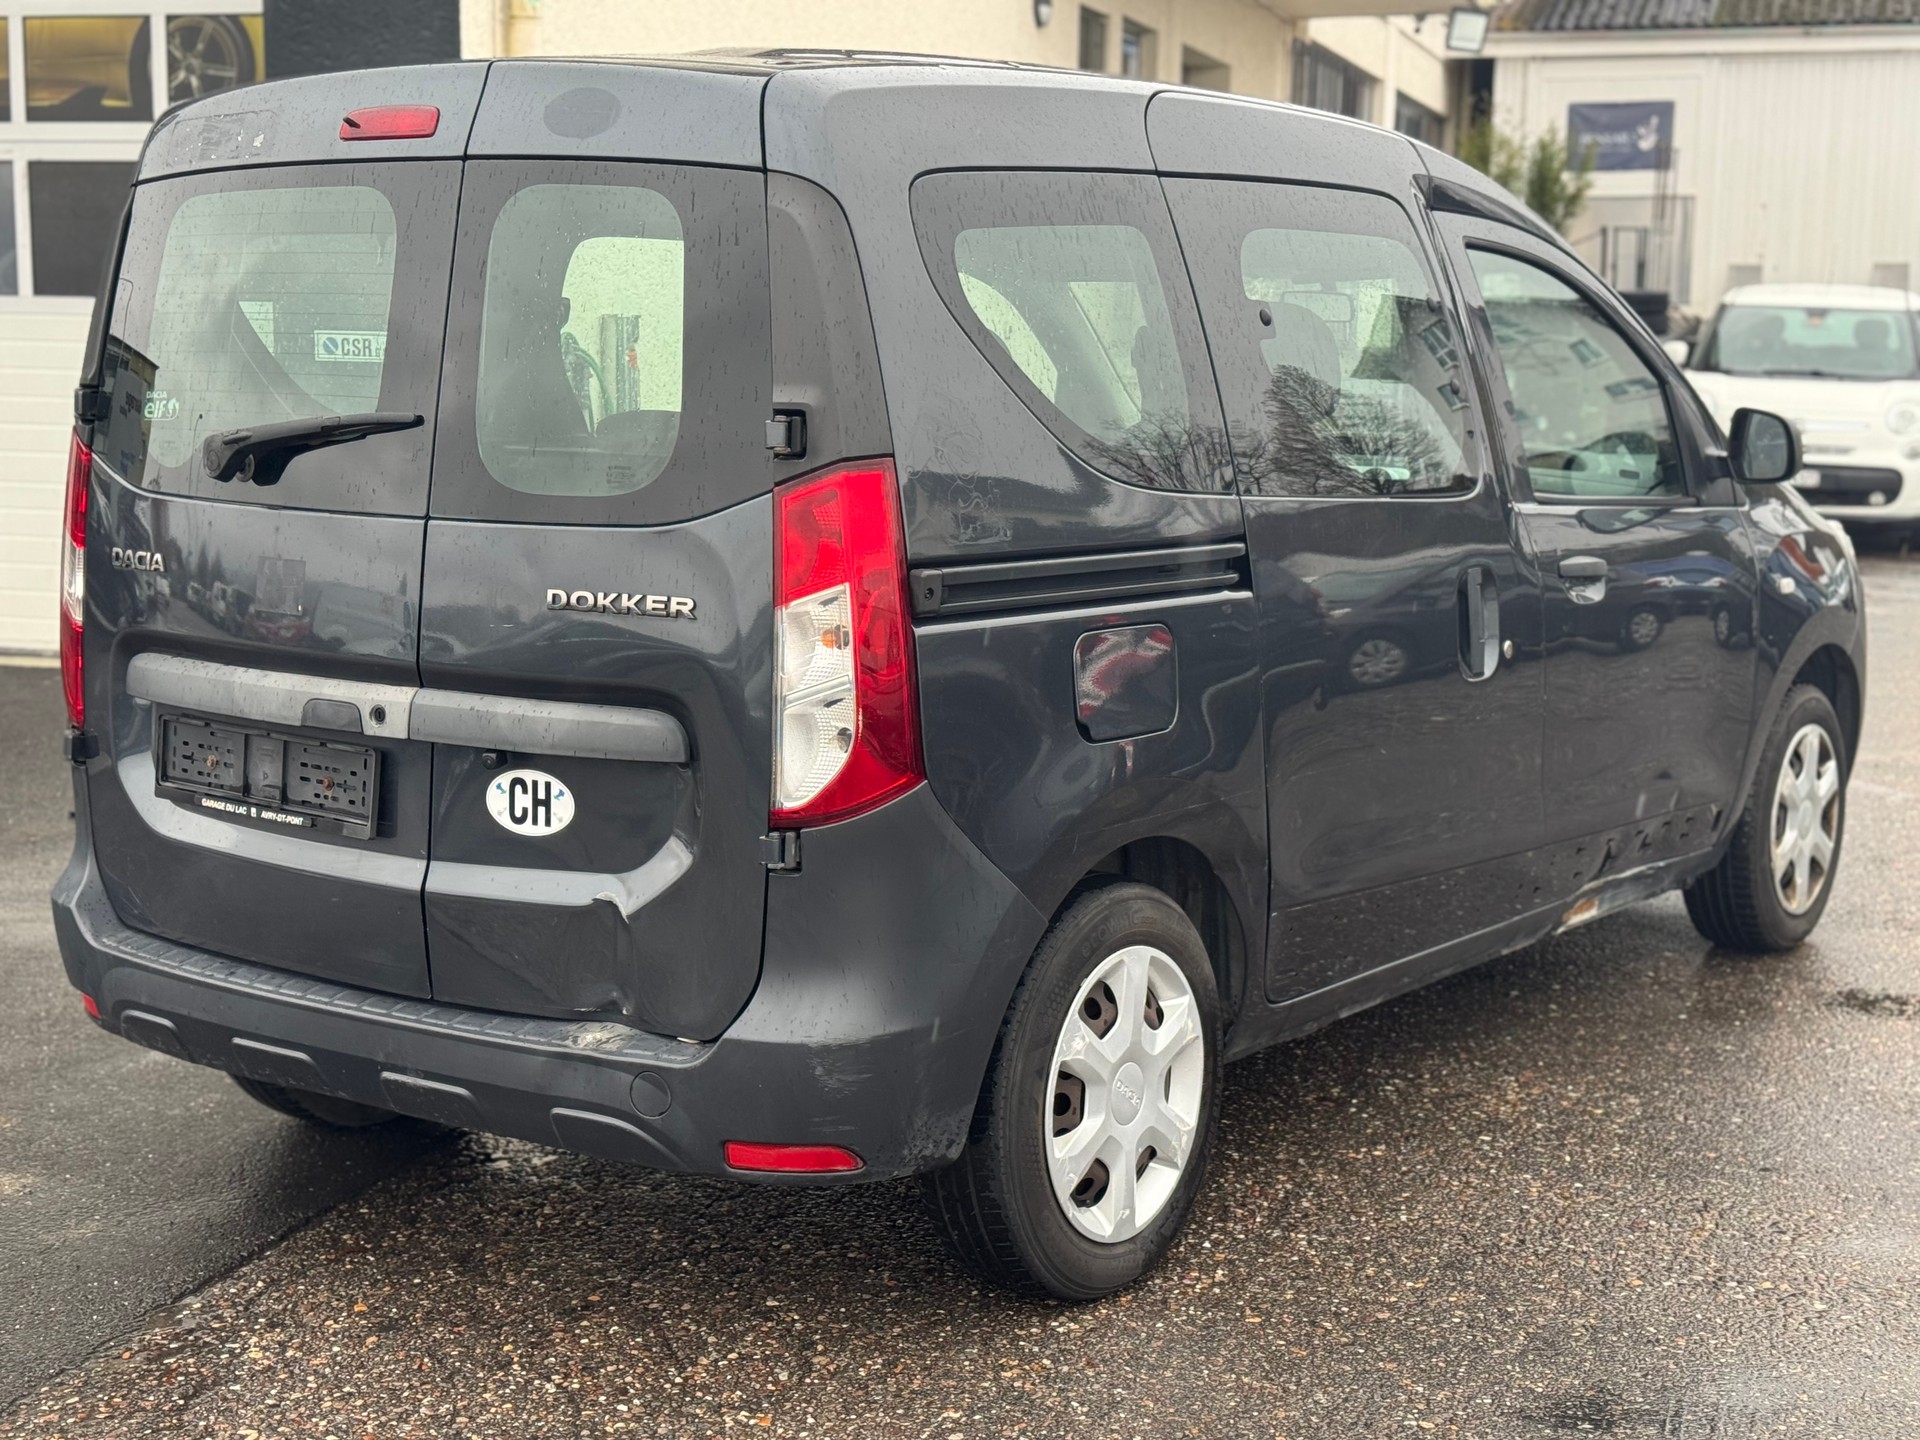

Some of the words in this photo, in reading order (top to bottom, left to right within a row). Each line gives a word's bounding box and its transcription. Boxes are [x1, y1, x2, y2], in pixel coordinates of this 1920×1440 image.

[341, 337, 372, 357] CSR
[146, 391, 167, 399] DACIA
[144, 400, 167, 418] elf
[112, 547, 165, 572] DACIA
[546, 588, 697, 619] DOKKER
[201, 798, 225, 811] GARAGE
[225, 803, 235, 812] DU
[235, 804, 247, 815] LAC
[509, 776, 552, 828] CH
